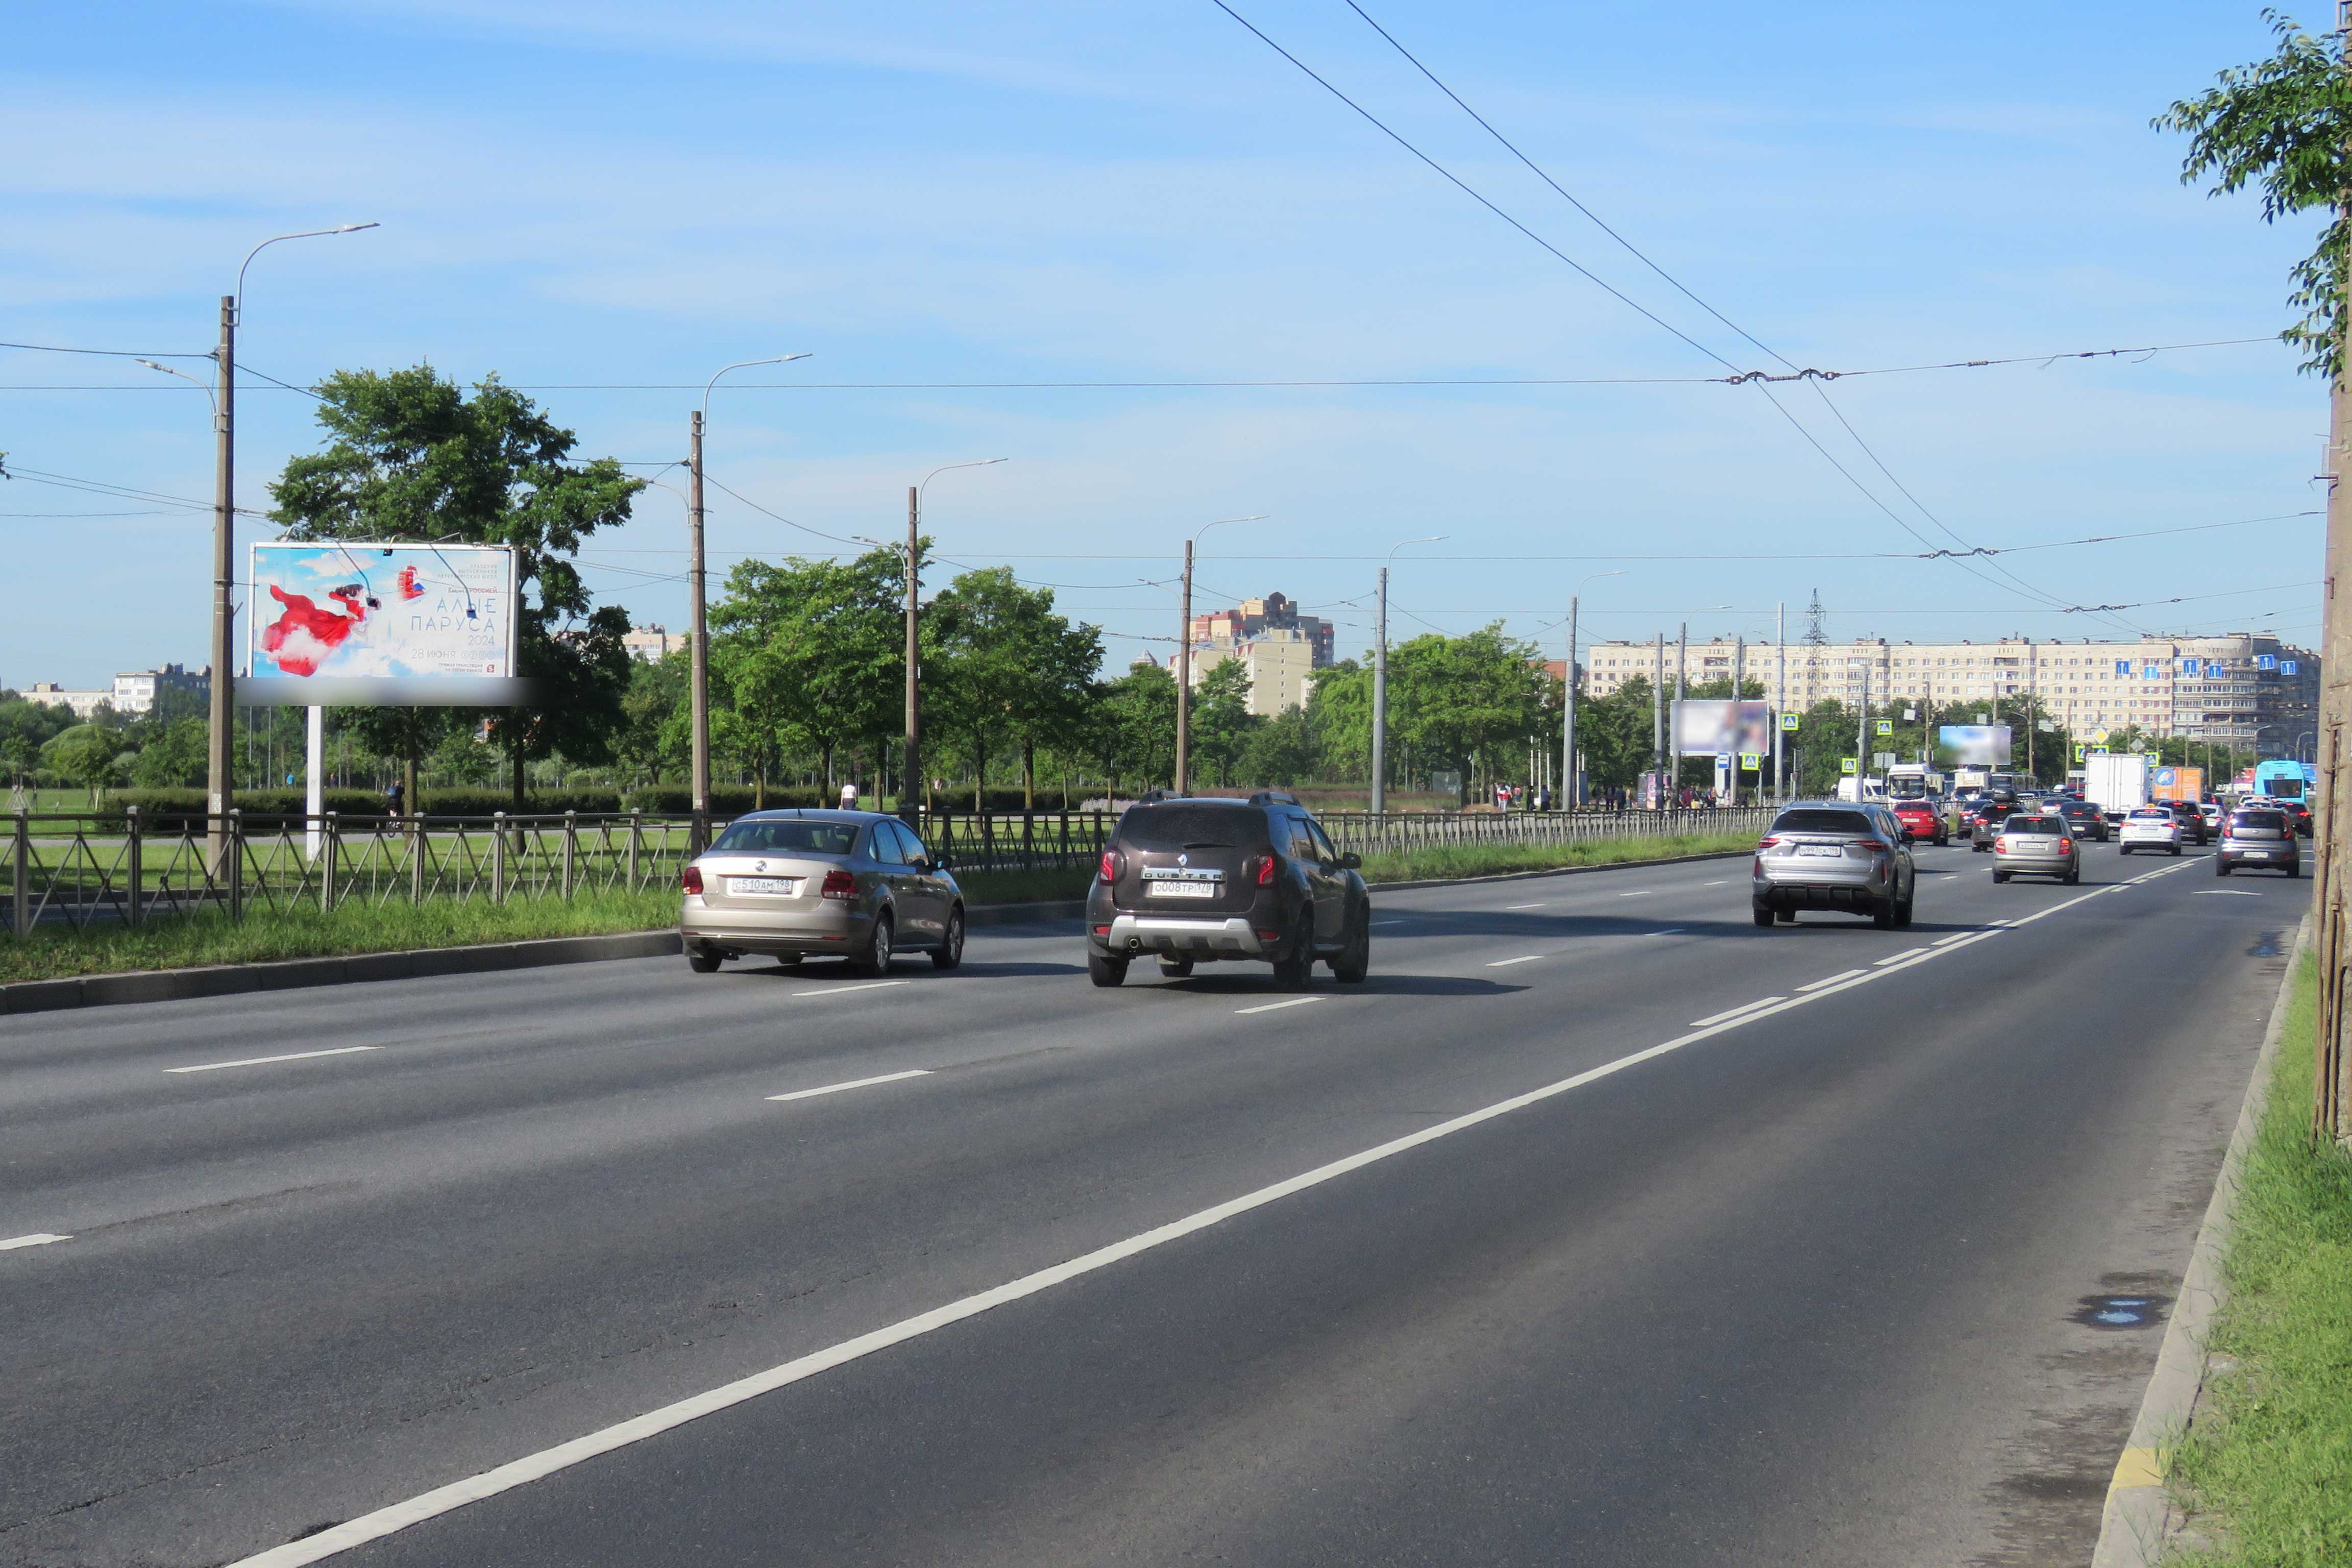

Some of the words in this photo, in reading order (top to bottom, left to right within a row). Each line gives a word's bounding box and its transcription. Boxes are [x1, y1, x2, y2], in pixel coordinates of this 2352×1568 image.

[437, 598, 496, 613] АЛЫЕ
[411, 616, 495, 631] ПАРУСА
[468, 635, 495, 645] 2024
[411, 649, 424, 658] 28
[427, 650, 456, 658] ИЮНЯ
[735, 879, 773, 890] С510АМ
